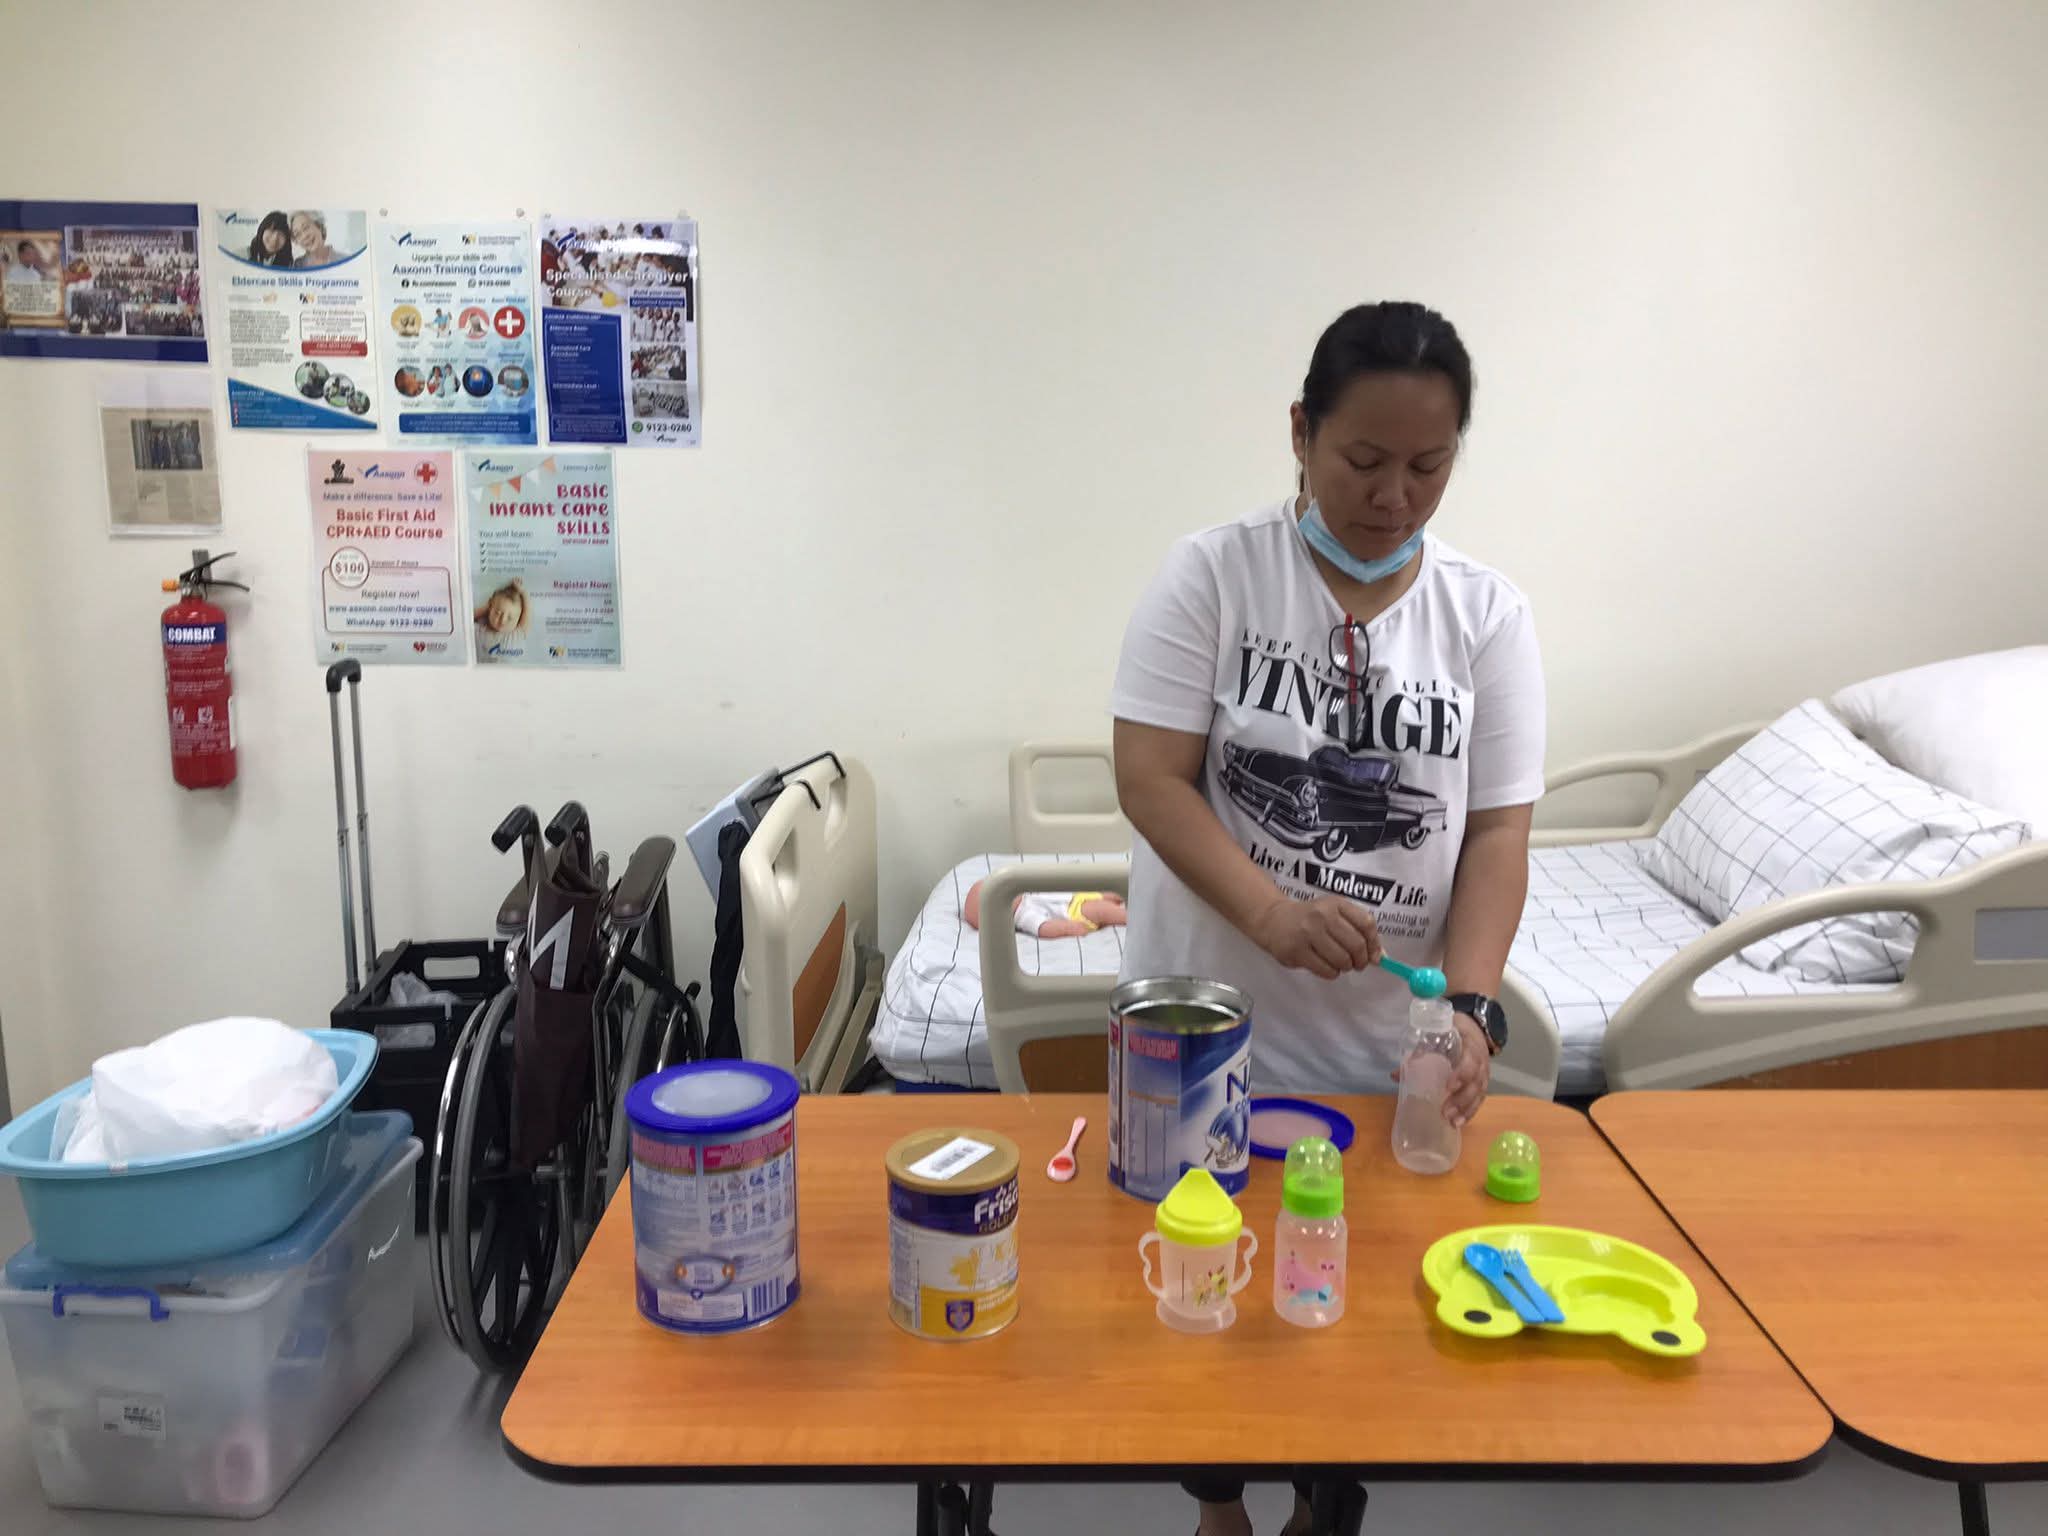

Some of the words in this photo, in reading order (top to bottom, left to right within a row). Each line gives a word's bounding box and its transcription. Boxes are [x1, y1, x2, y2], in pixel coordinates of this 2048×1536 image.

[462, 253, 481, 261] skills
[434, 264, 477, 276] Training
[478, 264, 523, 275] Courses
[546, 268, 622, 283] Specialised
[624, 269, 688, 284] Caregiver
[231, 275, 276, 287] Eldercare
[278, 276, 303, 288] Skills
[305, 276, 359, 289] Programme
[547, 286, 592, 298] Course
[646, 422, 692, 433] 9123-0280
[324, 492, 344, 501] Make
[557, 482, 609, 499] Basic
[336, 508, 374, 522] Basic
[377, 508, 409, 521] First
[413, 508, 436, 522] Aid
[326, 524, 391, 539] CPR+AED
[395, 525, 443, 539] Course
[335, 561, 365, 575] $100
[553, 580, 588, 591] Register
[361, 589, 397, 601] Register
[399, 590, 420, 599] now!
[168, 626, 216, 642] COMBAT
[1249, 841, 1285, 874] Live
[1288, 859, 1300, 879] A
[1314, 867, 1384, 901] Modern
[1393, 885, 1428, 908] Life
[1376, 911, 1418, 927] pushing
